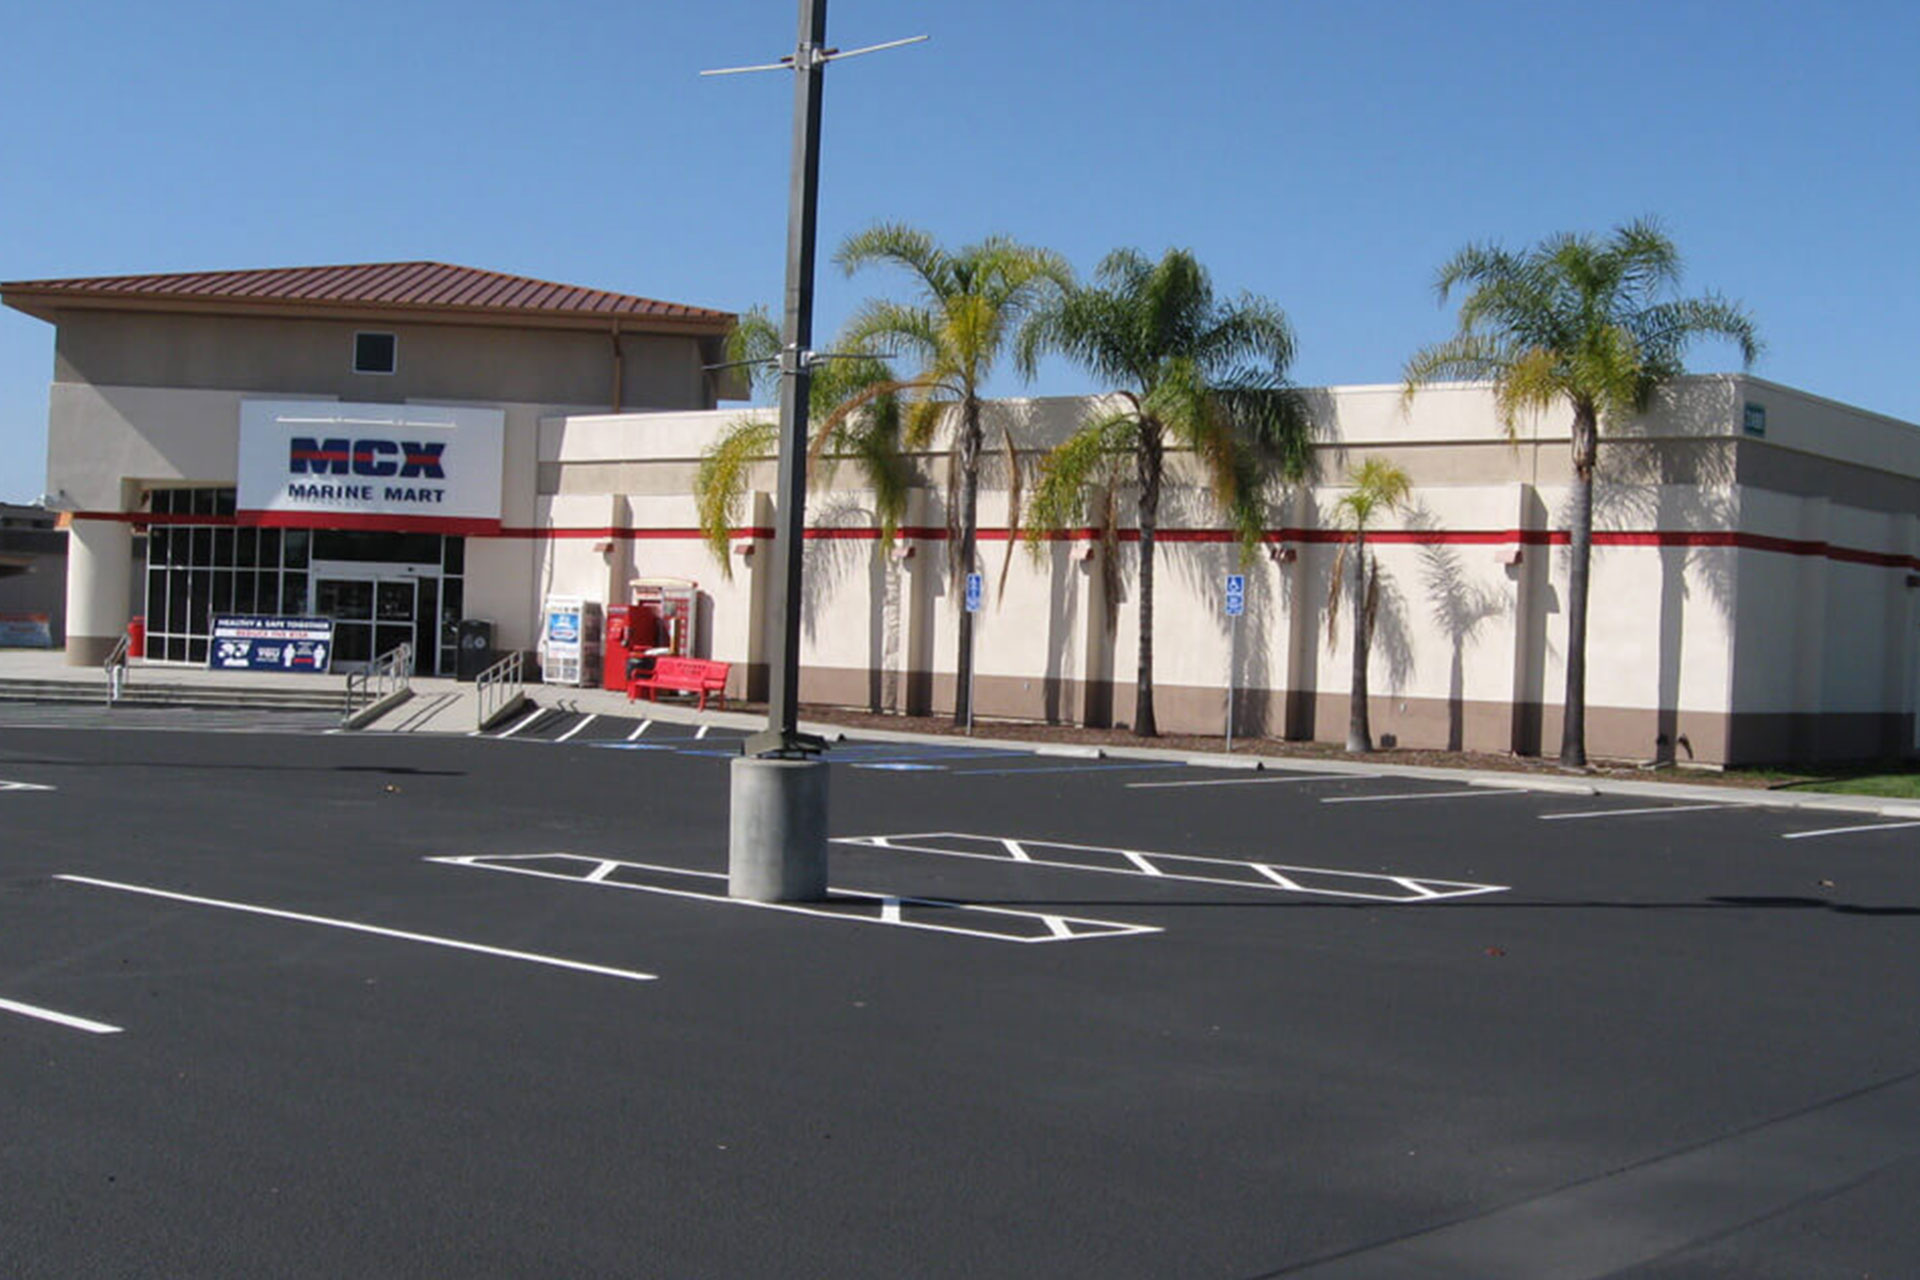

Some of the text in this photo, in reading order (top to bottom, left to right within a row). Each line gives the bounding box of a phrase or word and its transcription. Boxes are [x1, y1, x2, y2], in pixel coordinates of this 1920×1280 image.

[290, 437, 447, 479] MCX
[288, 483, 445, 503] MARINE MART
[218, 619, 255, 628] HEALTHY
[265, 620, 284, 628] SAFE
[287, 620, 329, 629] TOGETHER
